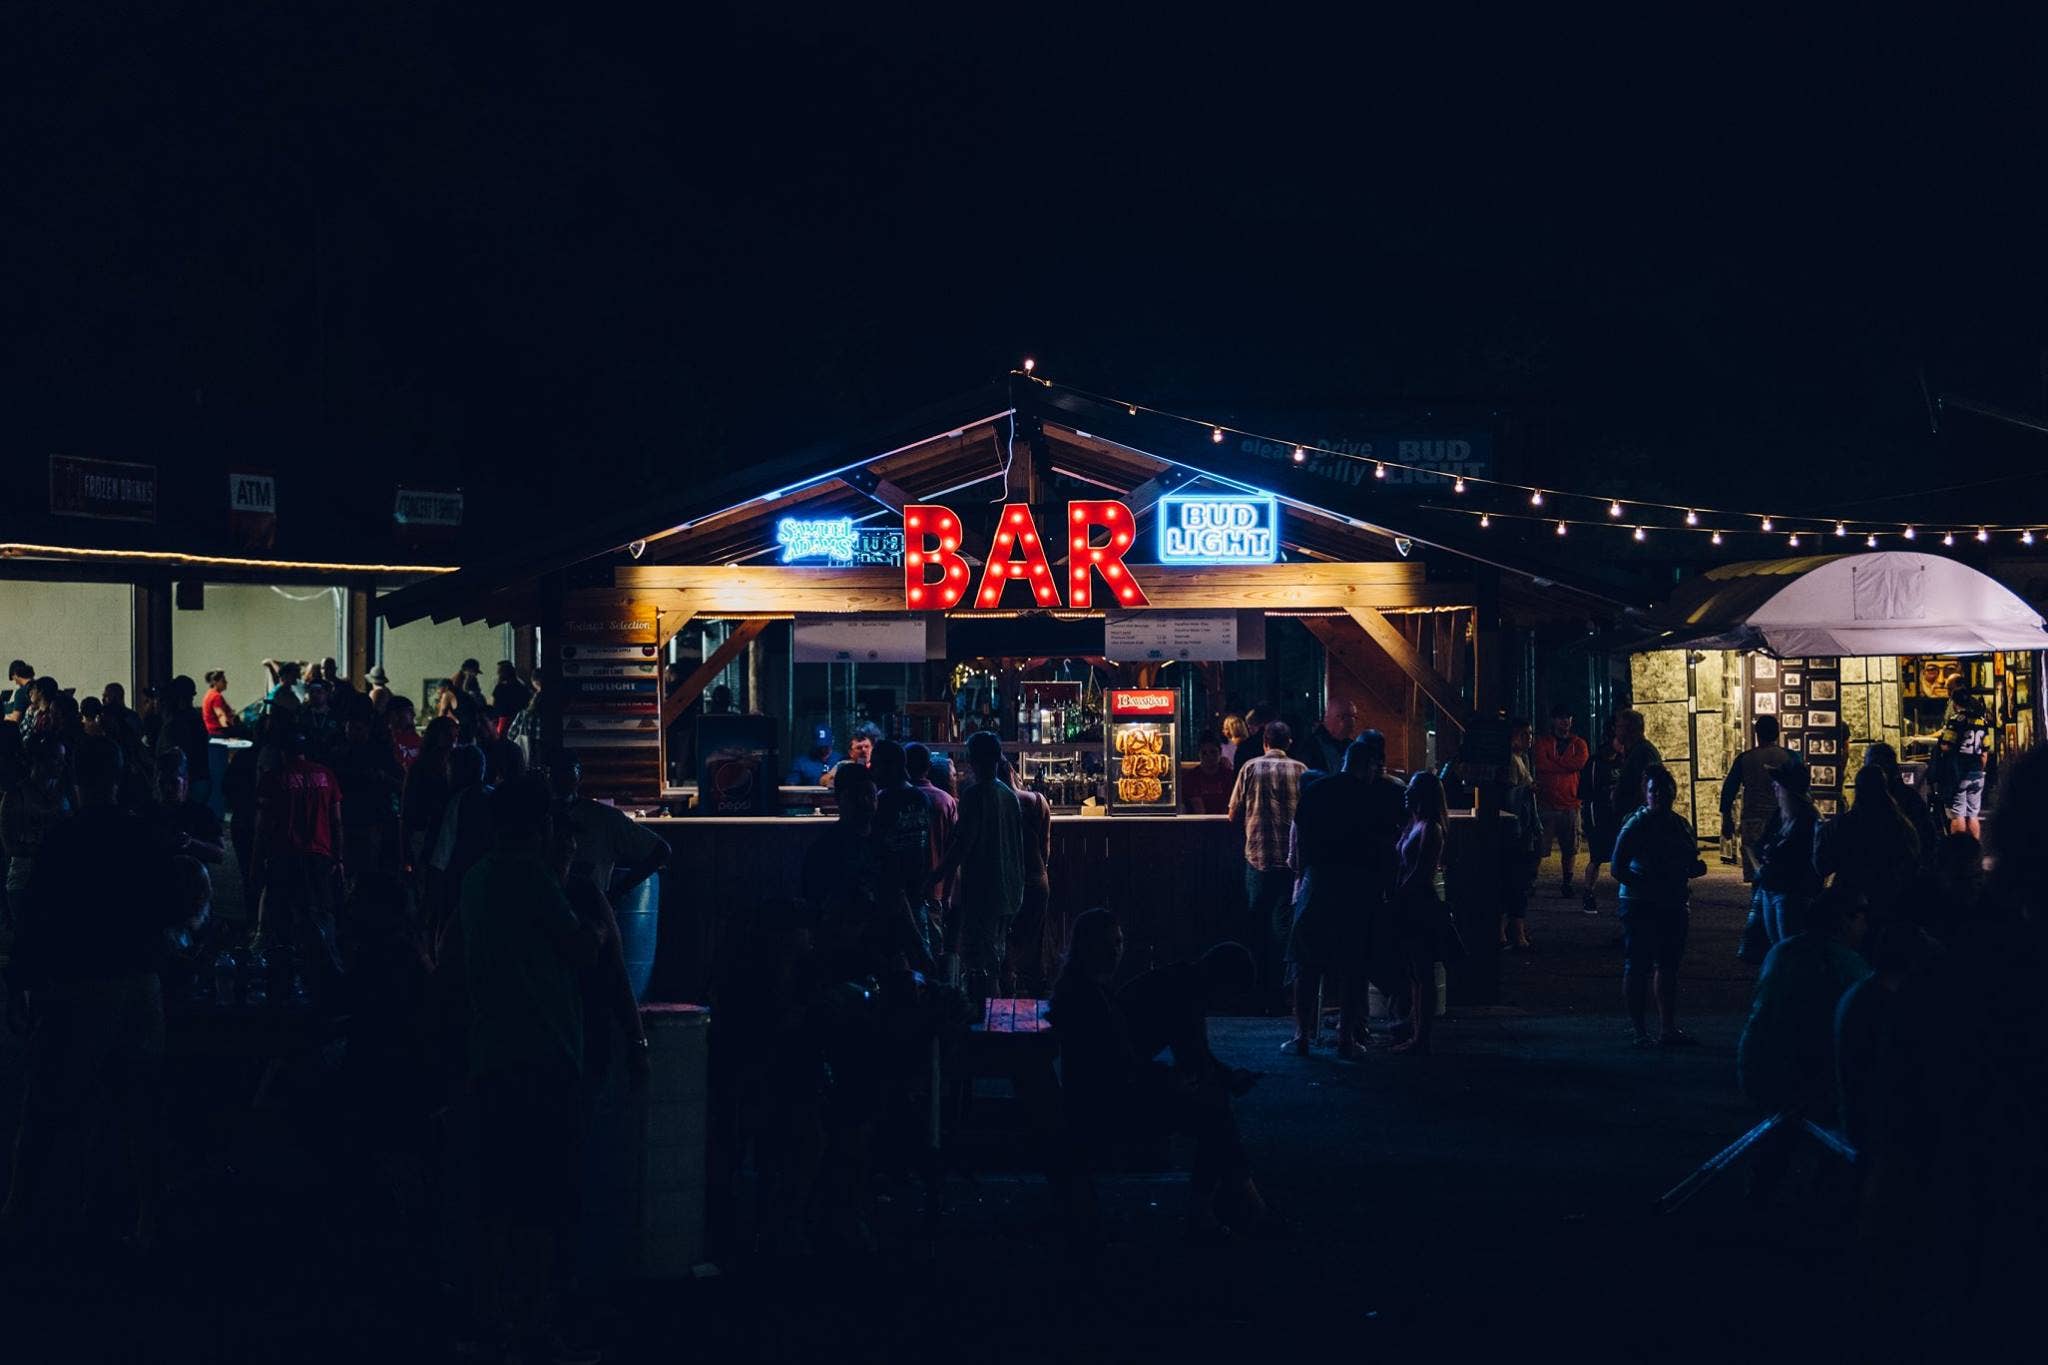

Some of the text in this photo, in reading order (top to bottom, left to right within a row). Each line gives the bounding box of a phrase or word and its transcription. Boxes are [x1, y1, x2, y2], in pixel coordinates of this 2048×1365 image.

[1397, 440, 1472, 462] BUD
[1385, 461, 1486, 485] LIGHT
[84, 474, 154, 503] FROZEN DRINKS
[237, 480, 270, 507] ATM
[1181, 503, 1258, 530] BUD
[903, 500, 1152, 609] BAR
[1166, 527, 1270, 555] LIGHT
[608, 619, 650, 632] Selection
[605, 682, 636, 691] LIGHT
